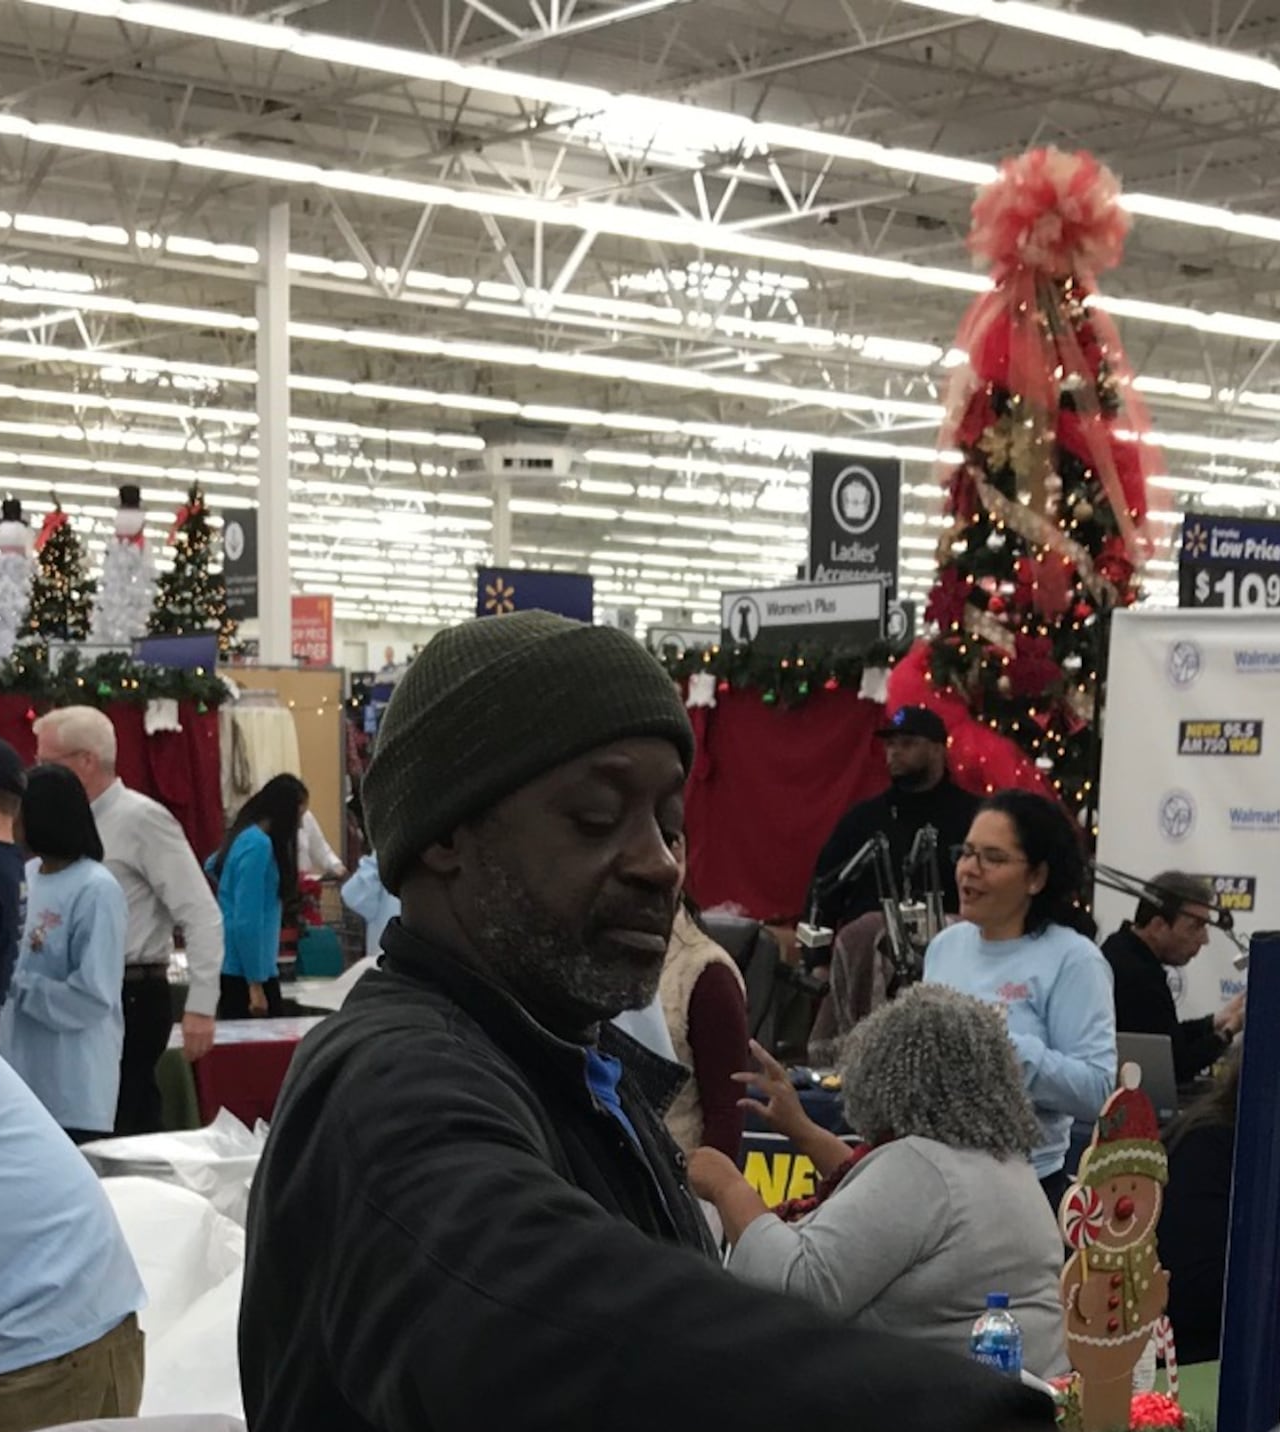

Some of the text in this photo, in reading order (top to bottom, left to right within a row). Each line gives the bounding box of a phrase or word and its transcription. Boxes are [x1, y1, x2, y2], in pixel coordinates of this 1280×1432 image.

[1209, 535, 1245, 559] Low
[766, 598, 837, 618] Women's Plus
[1185, 722, 1222, 738] NEWS
[1228, 737, 1259, 753] WSB
